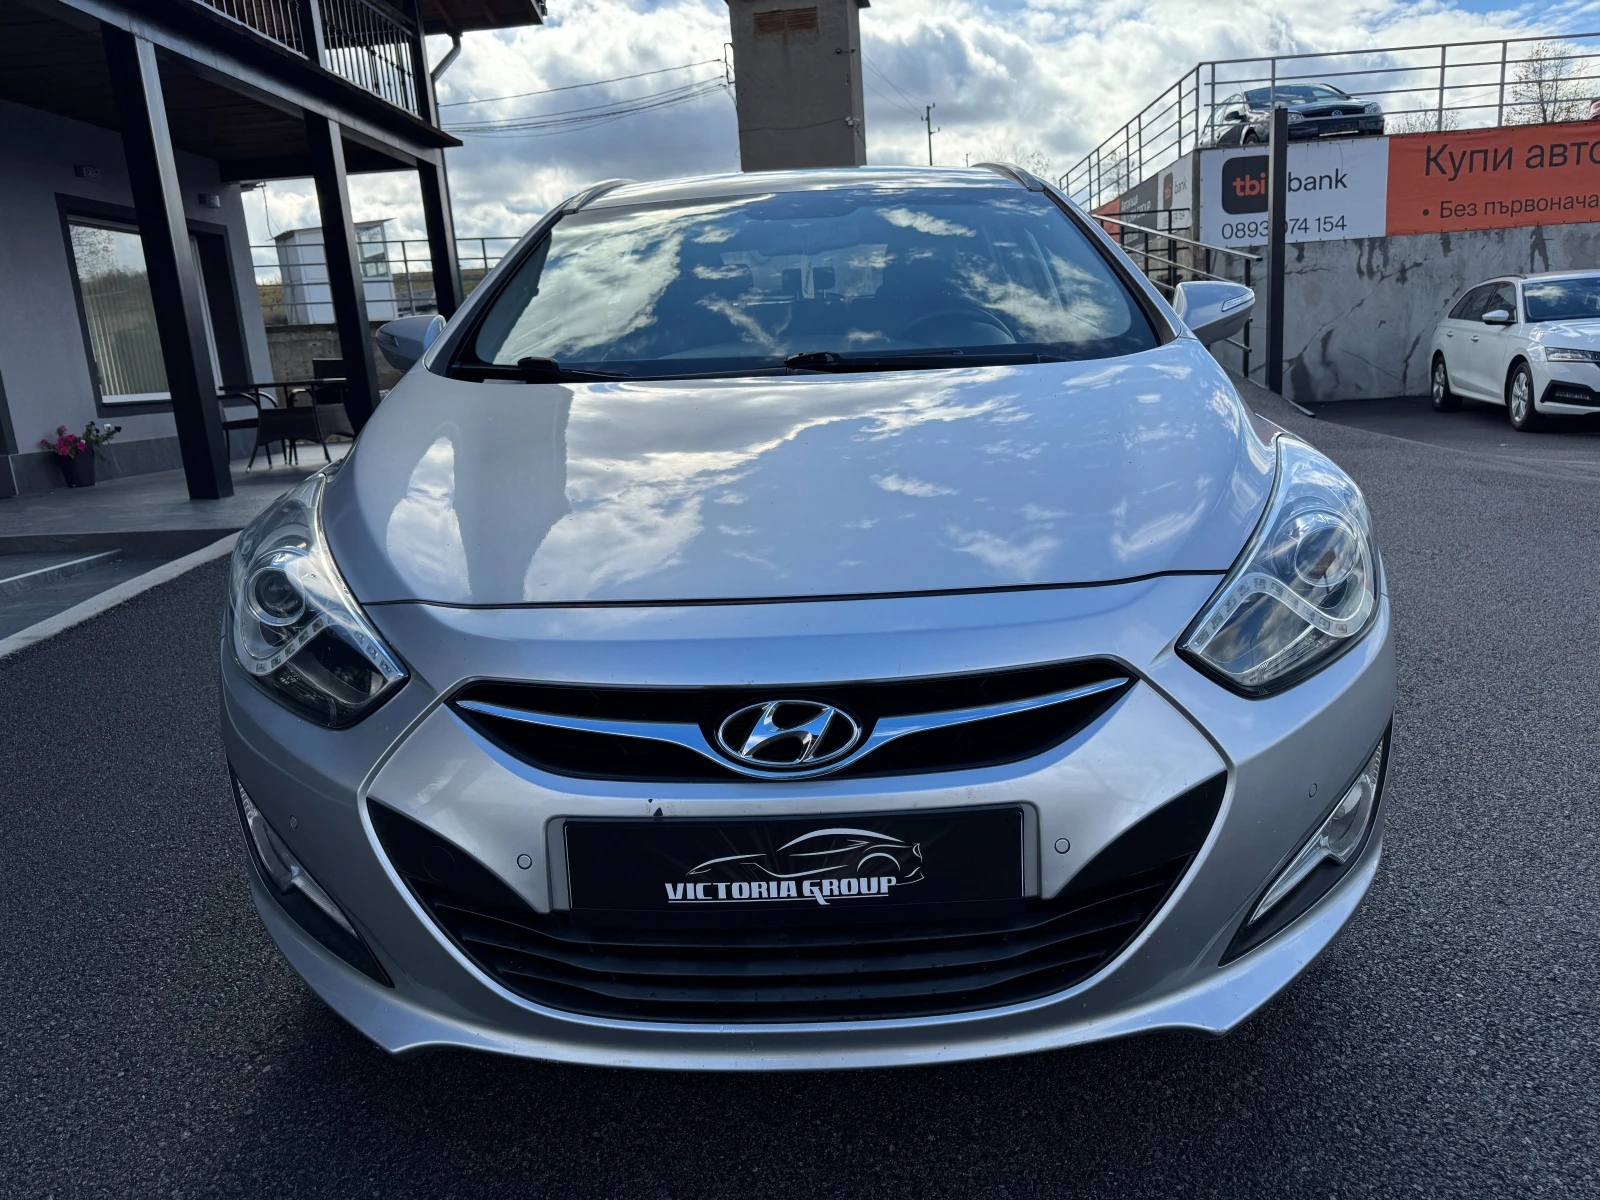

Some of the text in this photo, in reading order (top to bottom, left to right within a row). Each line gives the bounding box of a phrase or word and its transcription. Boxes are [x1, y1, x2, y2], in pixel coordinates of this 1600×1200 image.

[1425, 143, 1513, 182] Купи
[1232, 168, 1348, 197] tbi bank
[1440, 194, 1600, 219] Без първонача
[1221, 215, 1348, 240] 0893 74 154
[664, 876, 897, 905] VICTORIA GROUP
